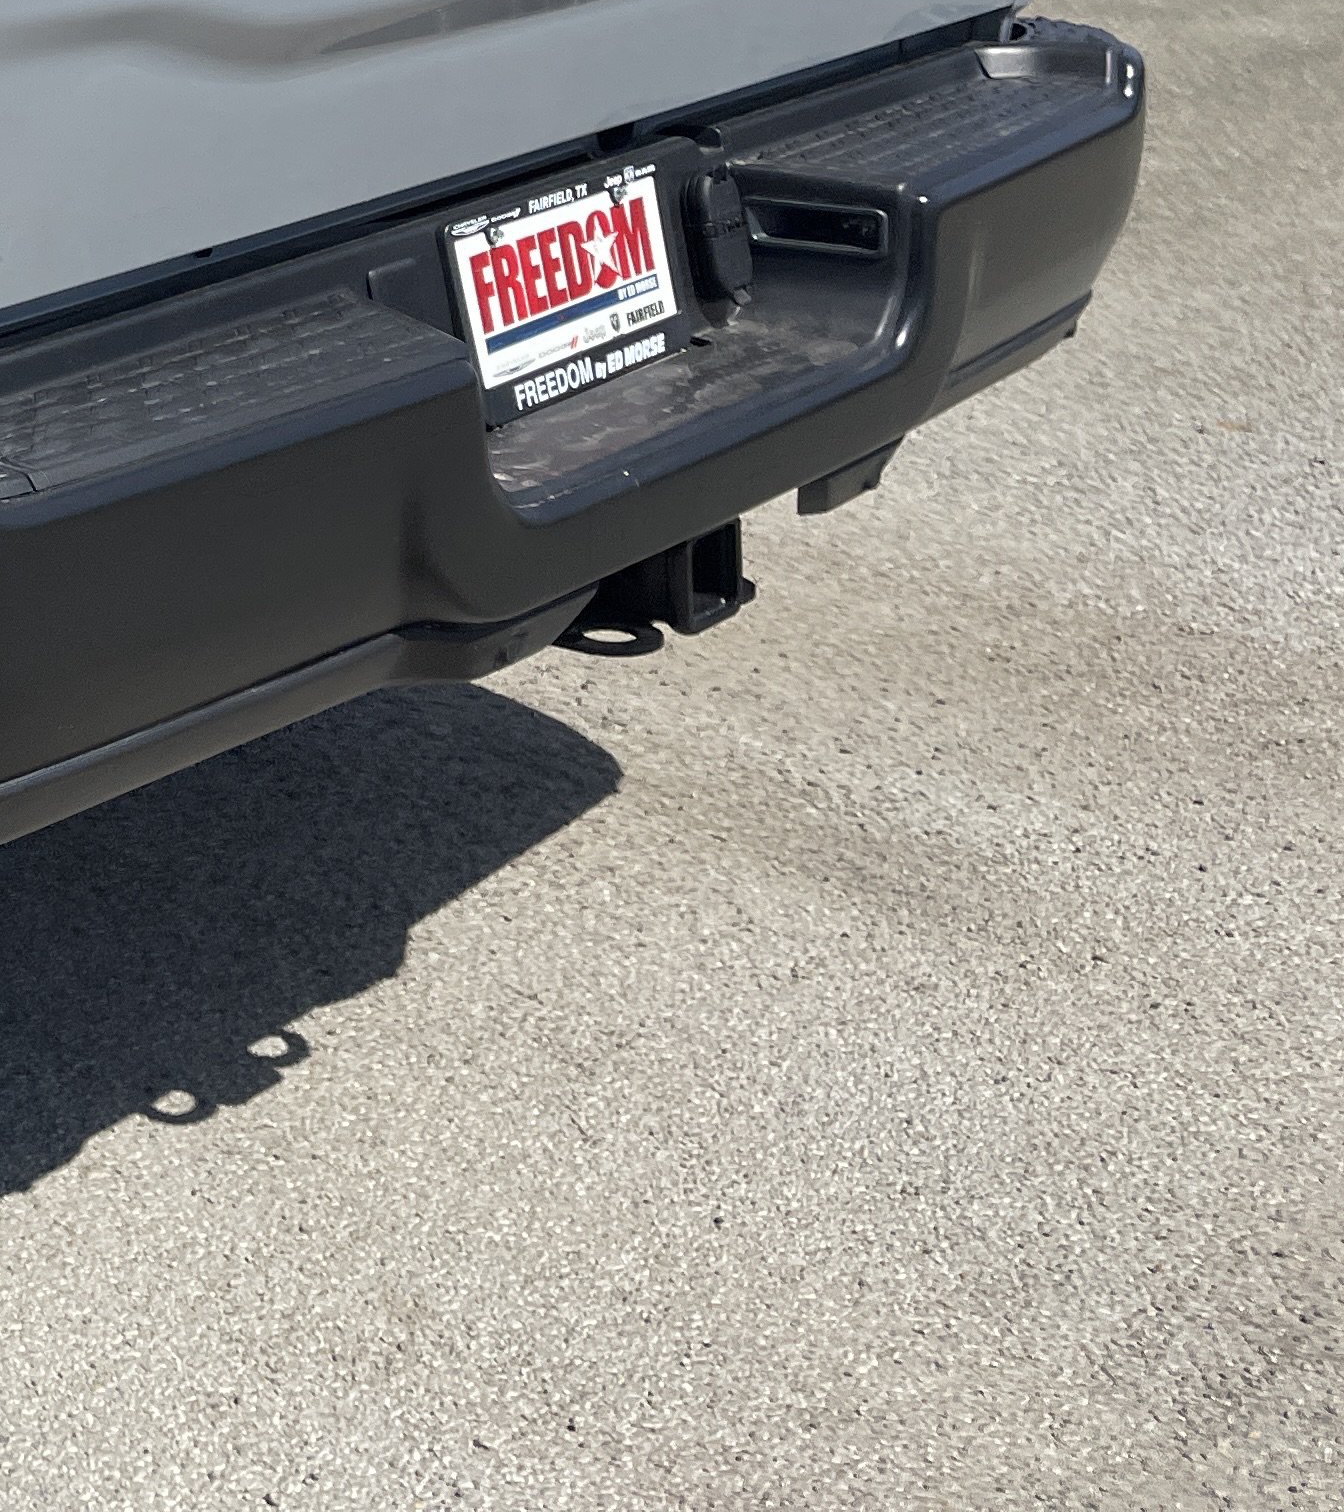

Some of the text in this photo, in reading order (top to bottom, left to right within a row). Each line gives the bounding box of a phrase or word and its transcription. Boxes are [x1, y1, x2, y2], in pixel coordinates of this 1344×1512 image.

[528, 183, 589, 215] FAIRFIELD, TX
[468, 196, 657, 335] FREEDOM
[626, 300, 665, 327] FAIRFIELD
[513, 356, 595, 411] FREEDOM
[606, 349, 624, 374] ED
[623, 332, 666, 367] MORSE
